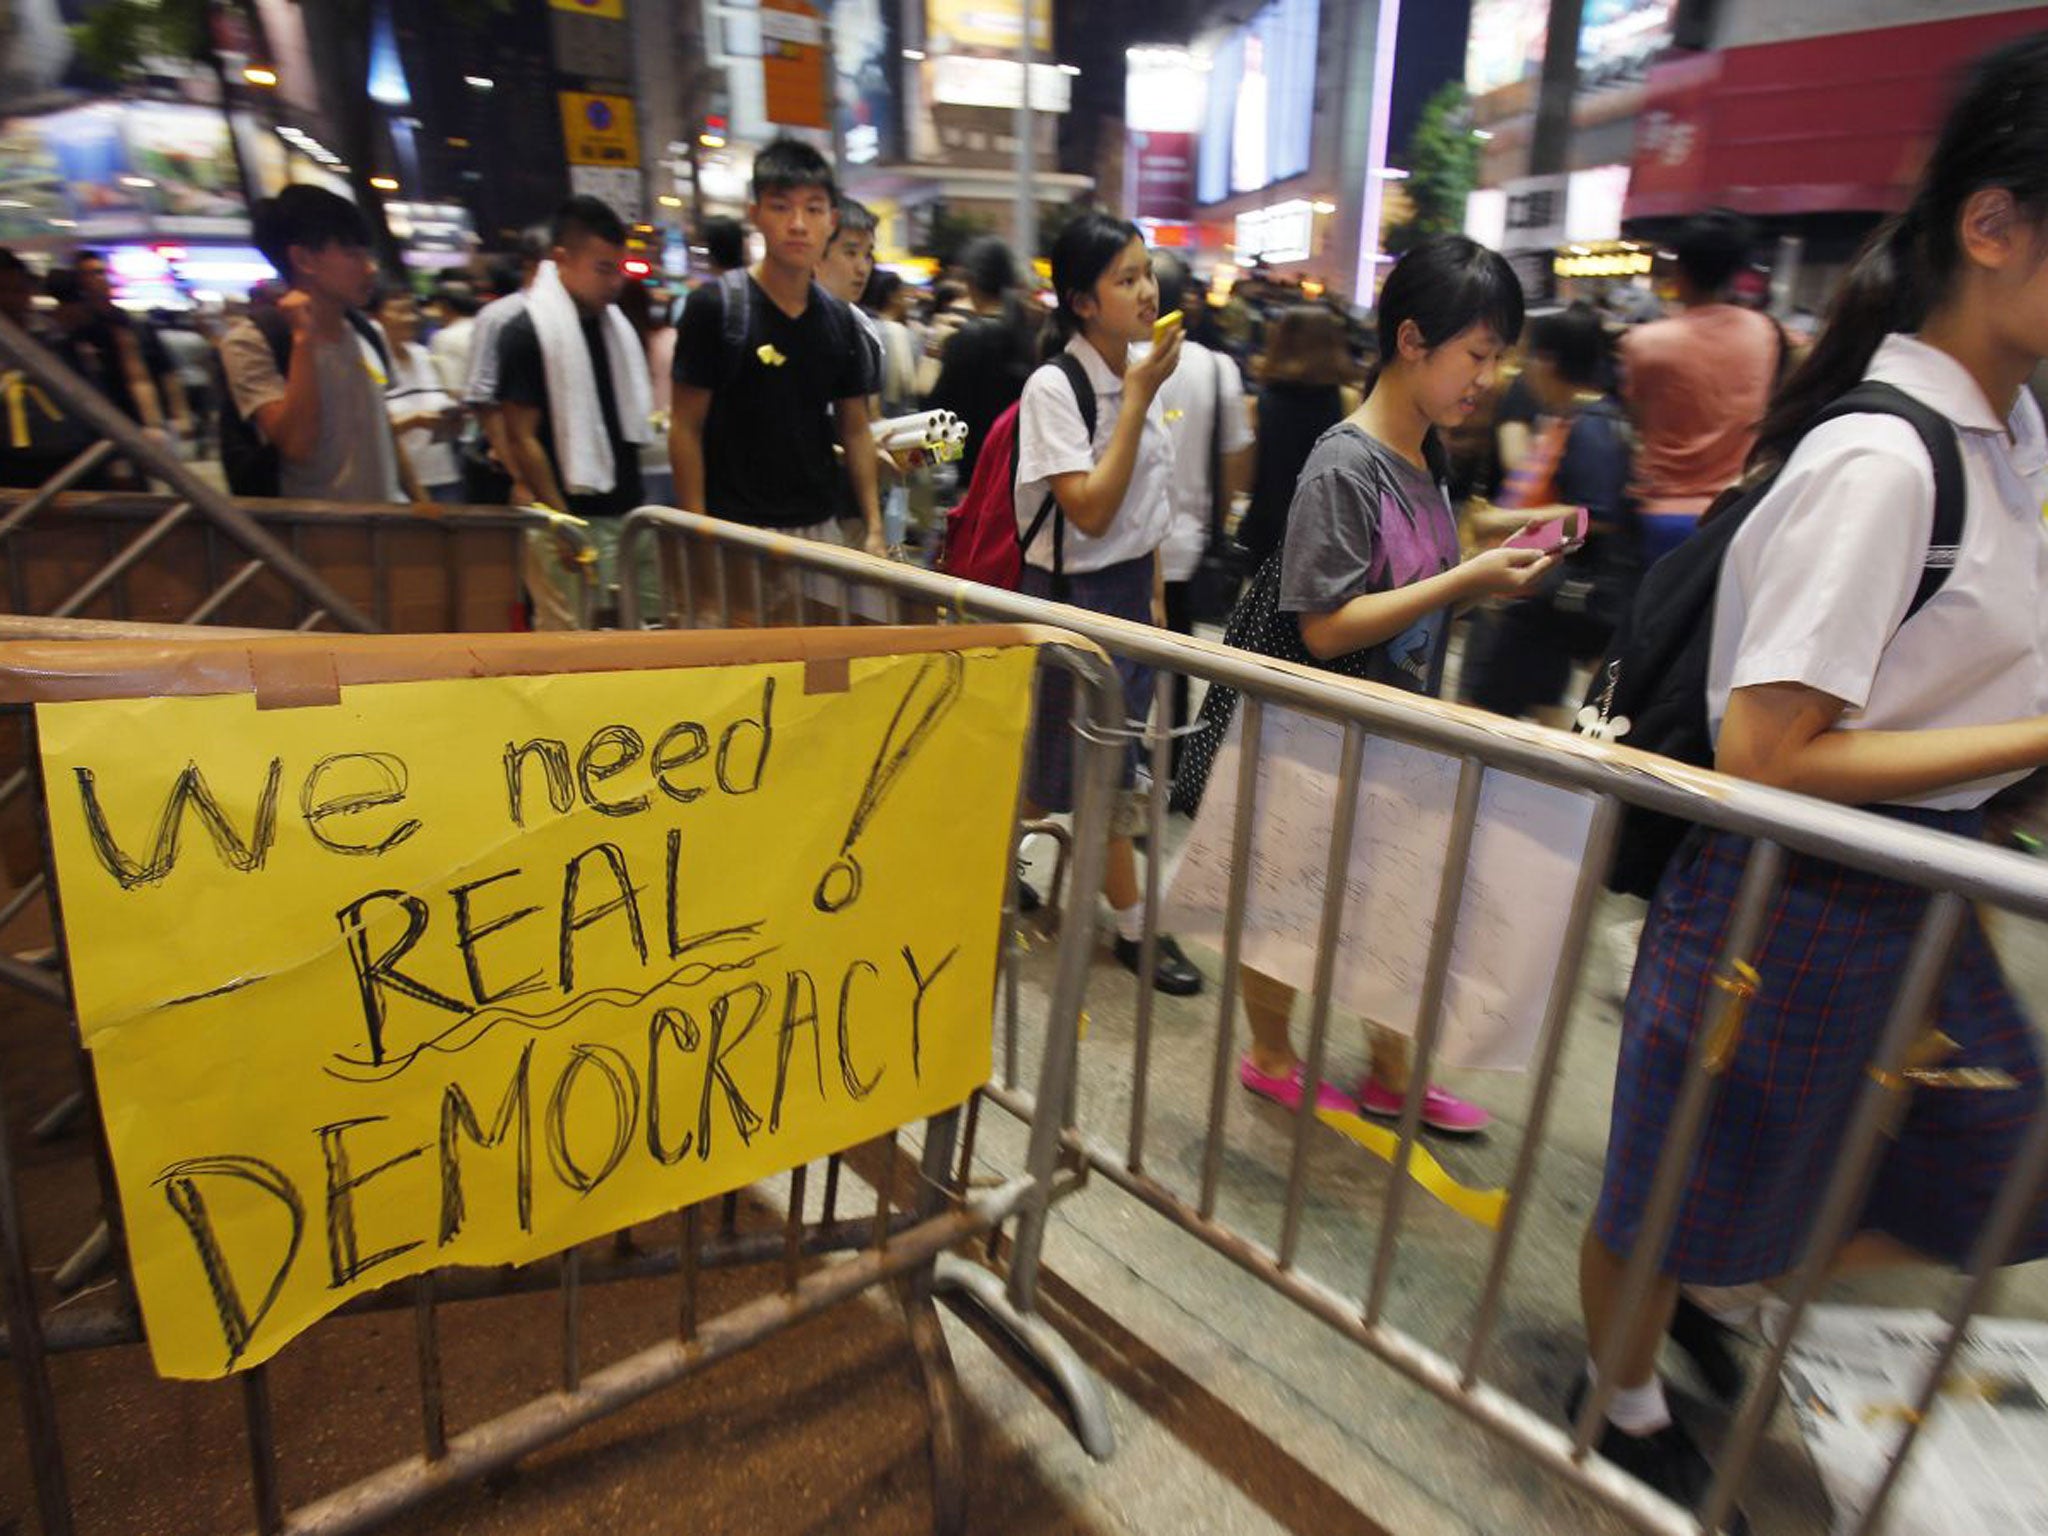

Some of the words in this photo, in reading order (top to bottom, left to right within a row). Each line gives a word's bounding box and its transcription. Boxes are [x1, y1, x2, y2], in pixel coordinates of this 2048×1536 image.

[74, 751, 424, 890] We
[503, 676, 777, 828] need
[336, 828, 767, 1068] REAL
[151, 945, 960, 1372] DEMOCRACY
